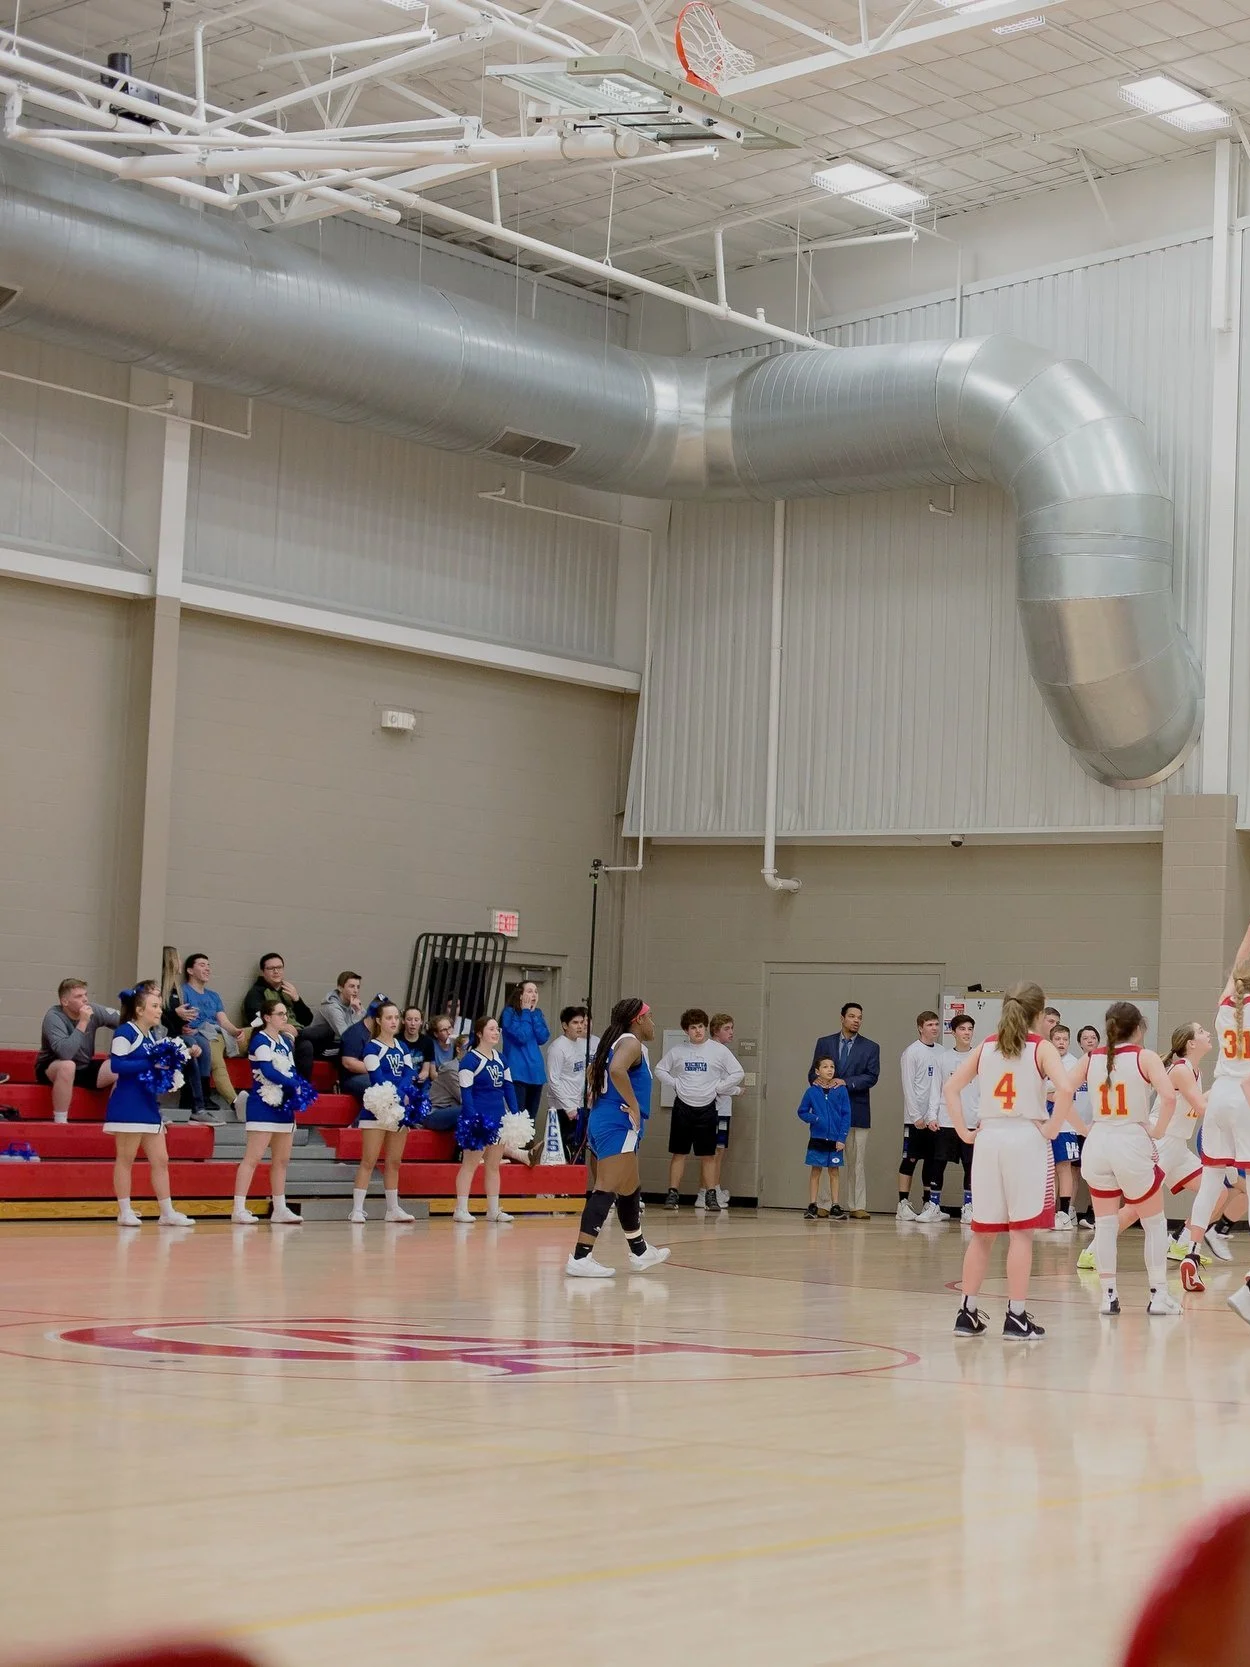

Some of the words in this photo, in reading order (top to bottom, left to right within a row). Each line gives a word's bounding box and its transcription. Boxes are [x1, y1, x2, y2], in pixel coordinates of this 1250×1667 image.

[498, 913, 516, 932] EXIT
[994, 1073, 1016, 1109] 4
[1099, 1083, 1128, 1115] 11
